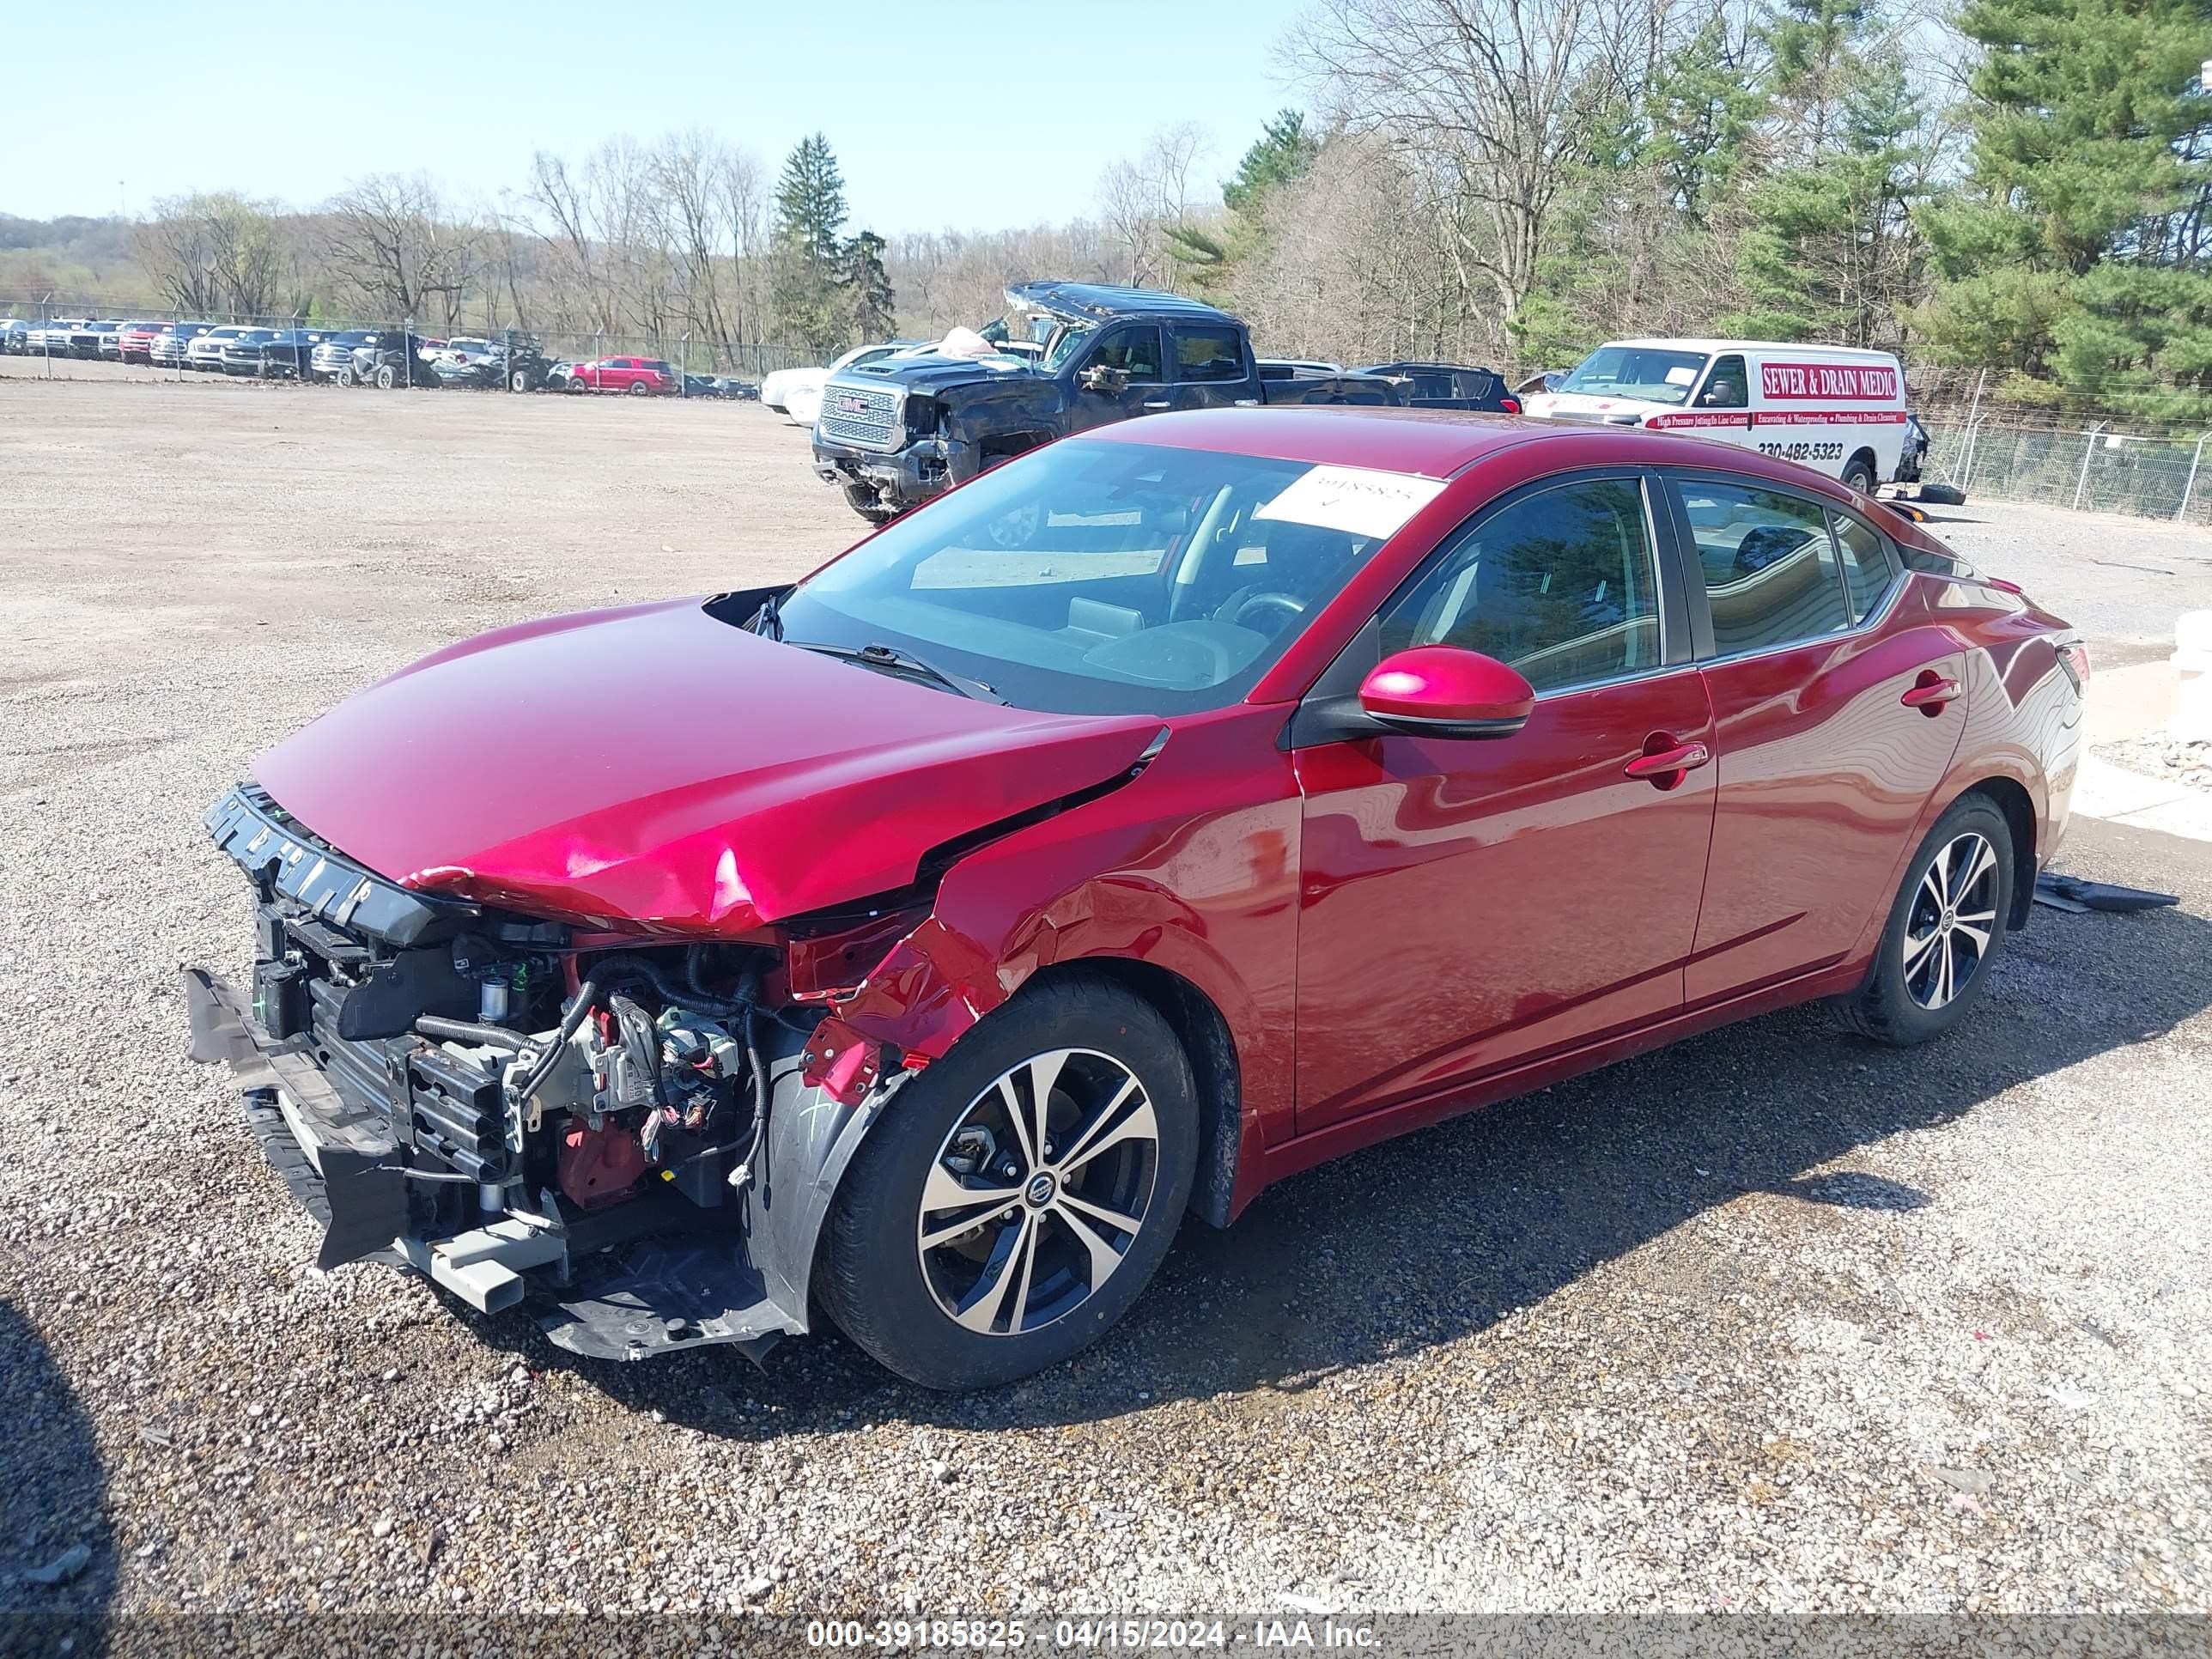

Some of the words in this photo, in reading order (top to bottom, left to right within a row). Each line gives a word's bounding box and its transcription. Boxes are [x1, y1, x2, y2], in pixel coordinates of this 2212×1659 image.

[1764, 368, 1807, 395] SEWER
[1809, 369, 1819, 395] &
[1820, 369, 1858, 396] DRAIN
[1859, 371, 1896, 397] MEDIC
[837, 398, 868, 414] GMC
[1657, 416, 1671, 428] High
[1672, 416, 1693, 426] Pressure
[1718, 416, 1729, 424] Line
[1729, 415, 1747, 424] Camera
[1758, 414, 1786, 425] Excavating
[1787, 415, 1792, 423] &
[1793, 414, 1828, 425] Waterproofing
[1835, 414, 1856, 423] Plumbing
[1857, 414, 1863, 422] &
[1863, 413, 1877, 422] Drain
[1877, 413, 1897, 422] Cleaning
